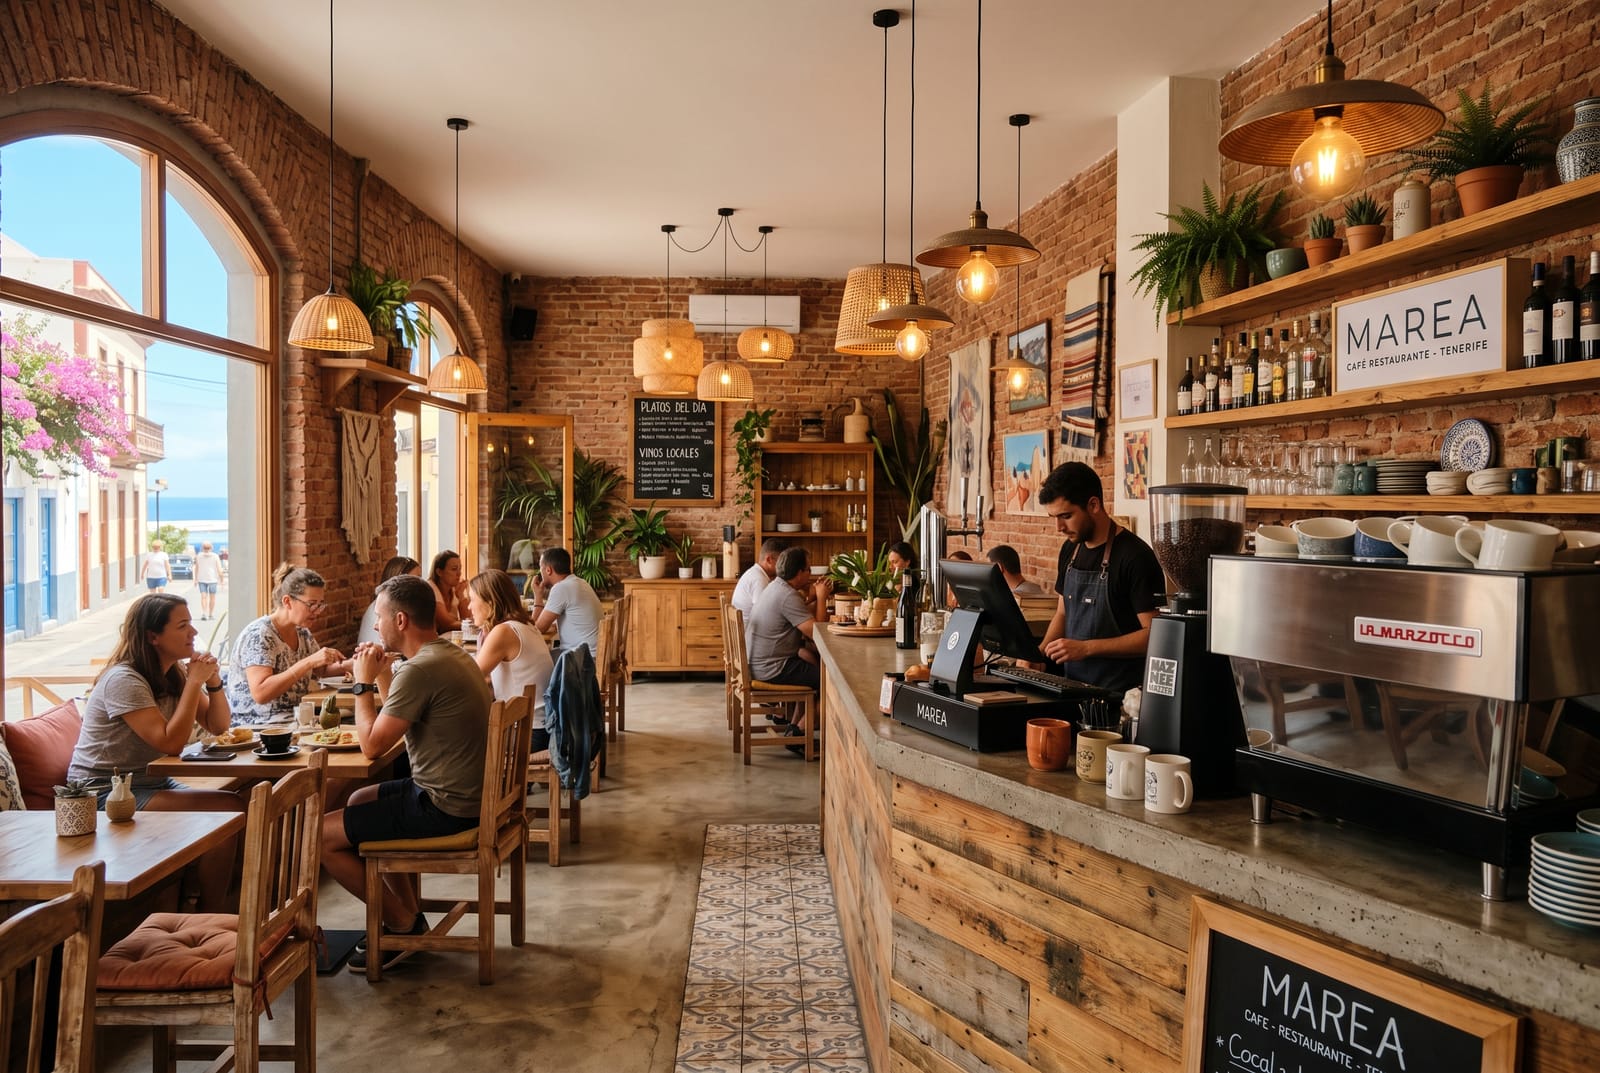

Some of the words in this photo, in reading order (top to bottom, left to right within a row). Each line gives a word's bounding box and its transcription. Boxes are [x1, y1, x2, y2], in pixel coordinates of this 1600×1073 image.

[1347, 294, 1487, 355] MAREA
[1346, 358, 1367, 371] CAFÉ
[1369, 350, 1430, 368] RESTAURANTE
[1440, 340, 1488, 356] TENERIFE
[640, 401, 671, 413] PLATOS
[675, 401, 690, 413] DEL
[692, 401, 707, 413] DÍA
[639, 447, 664, 458] VINOS
[666, 447, 700, 459] LOCALES
[1360, 623, 1374, 636] LA
[917, 702, 947, 727] MAREA
[1262, 965, 1406, 1071] MAREA
[1244, 1009, 1270, 1031] CAFE
[1278, 1024, 1353, 1069] RESTAURANTE
